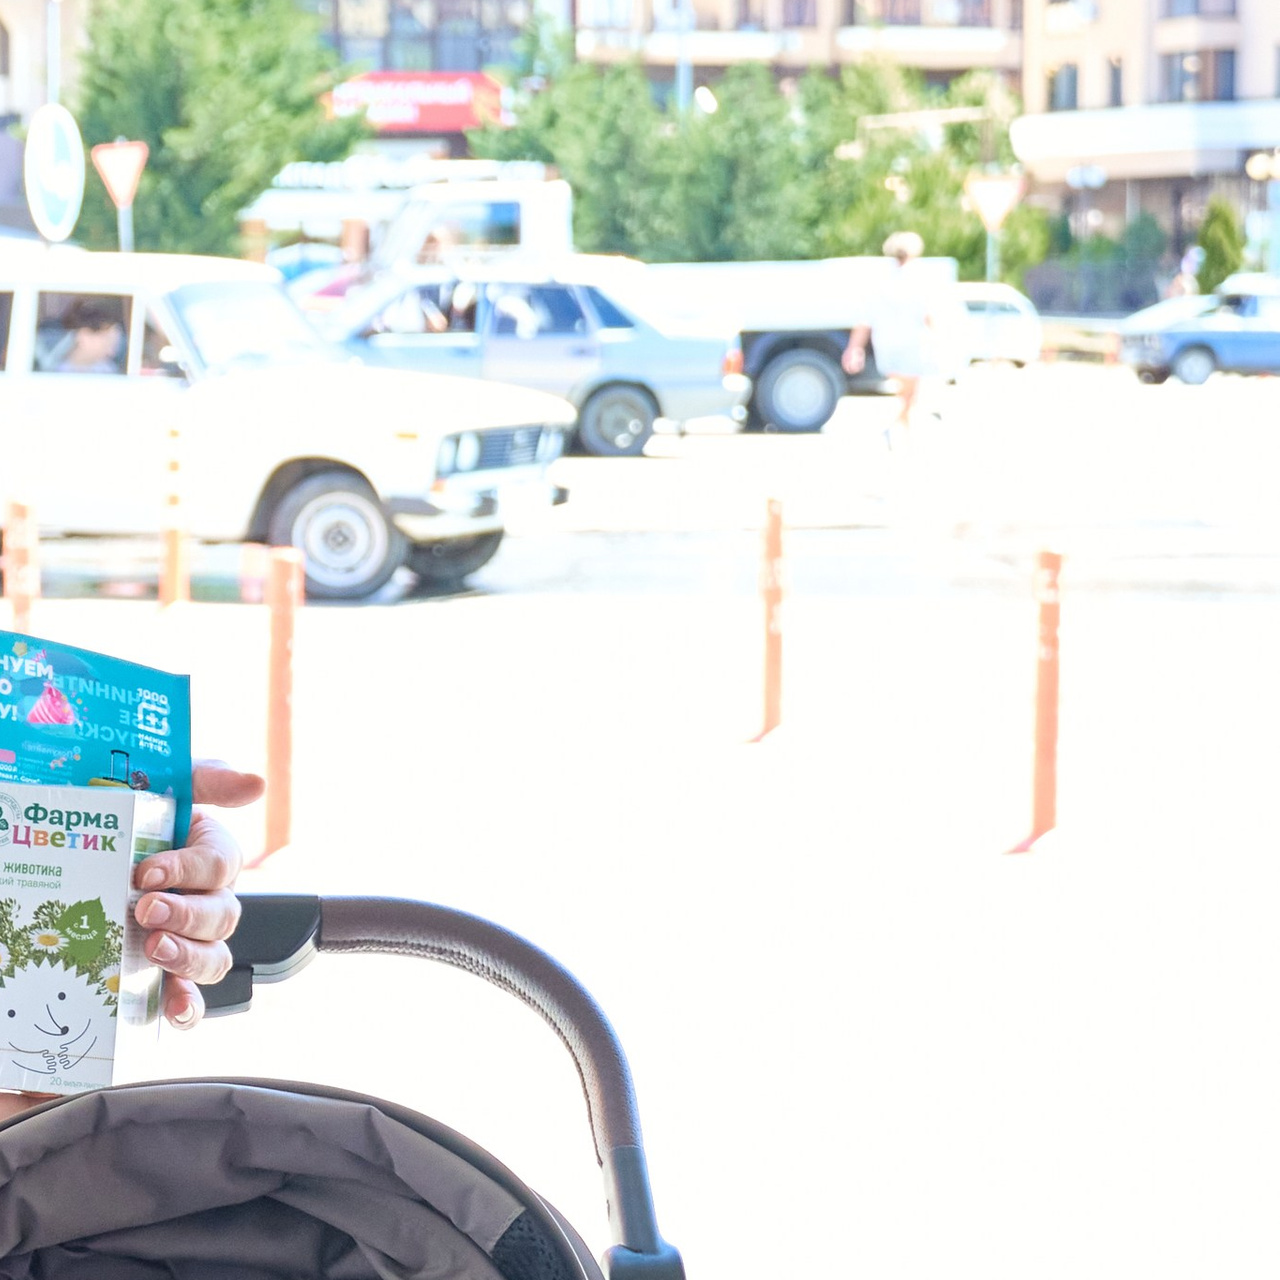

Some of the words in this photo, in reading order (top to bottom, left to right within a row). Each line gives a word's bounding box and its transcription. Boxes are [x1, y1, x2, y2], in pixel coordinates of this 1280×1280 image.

[24, 803, 119, 831] Фарма
[12, 824, 117, 852] Цветик
[3, 862, 62, 877] животика
[17, 879, 61, 889] травяной
[80, 915, 90, 929] 1
[65, 927, 98, 940] месяца
[50, 1076, 61, 1086] 20
